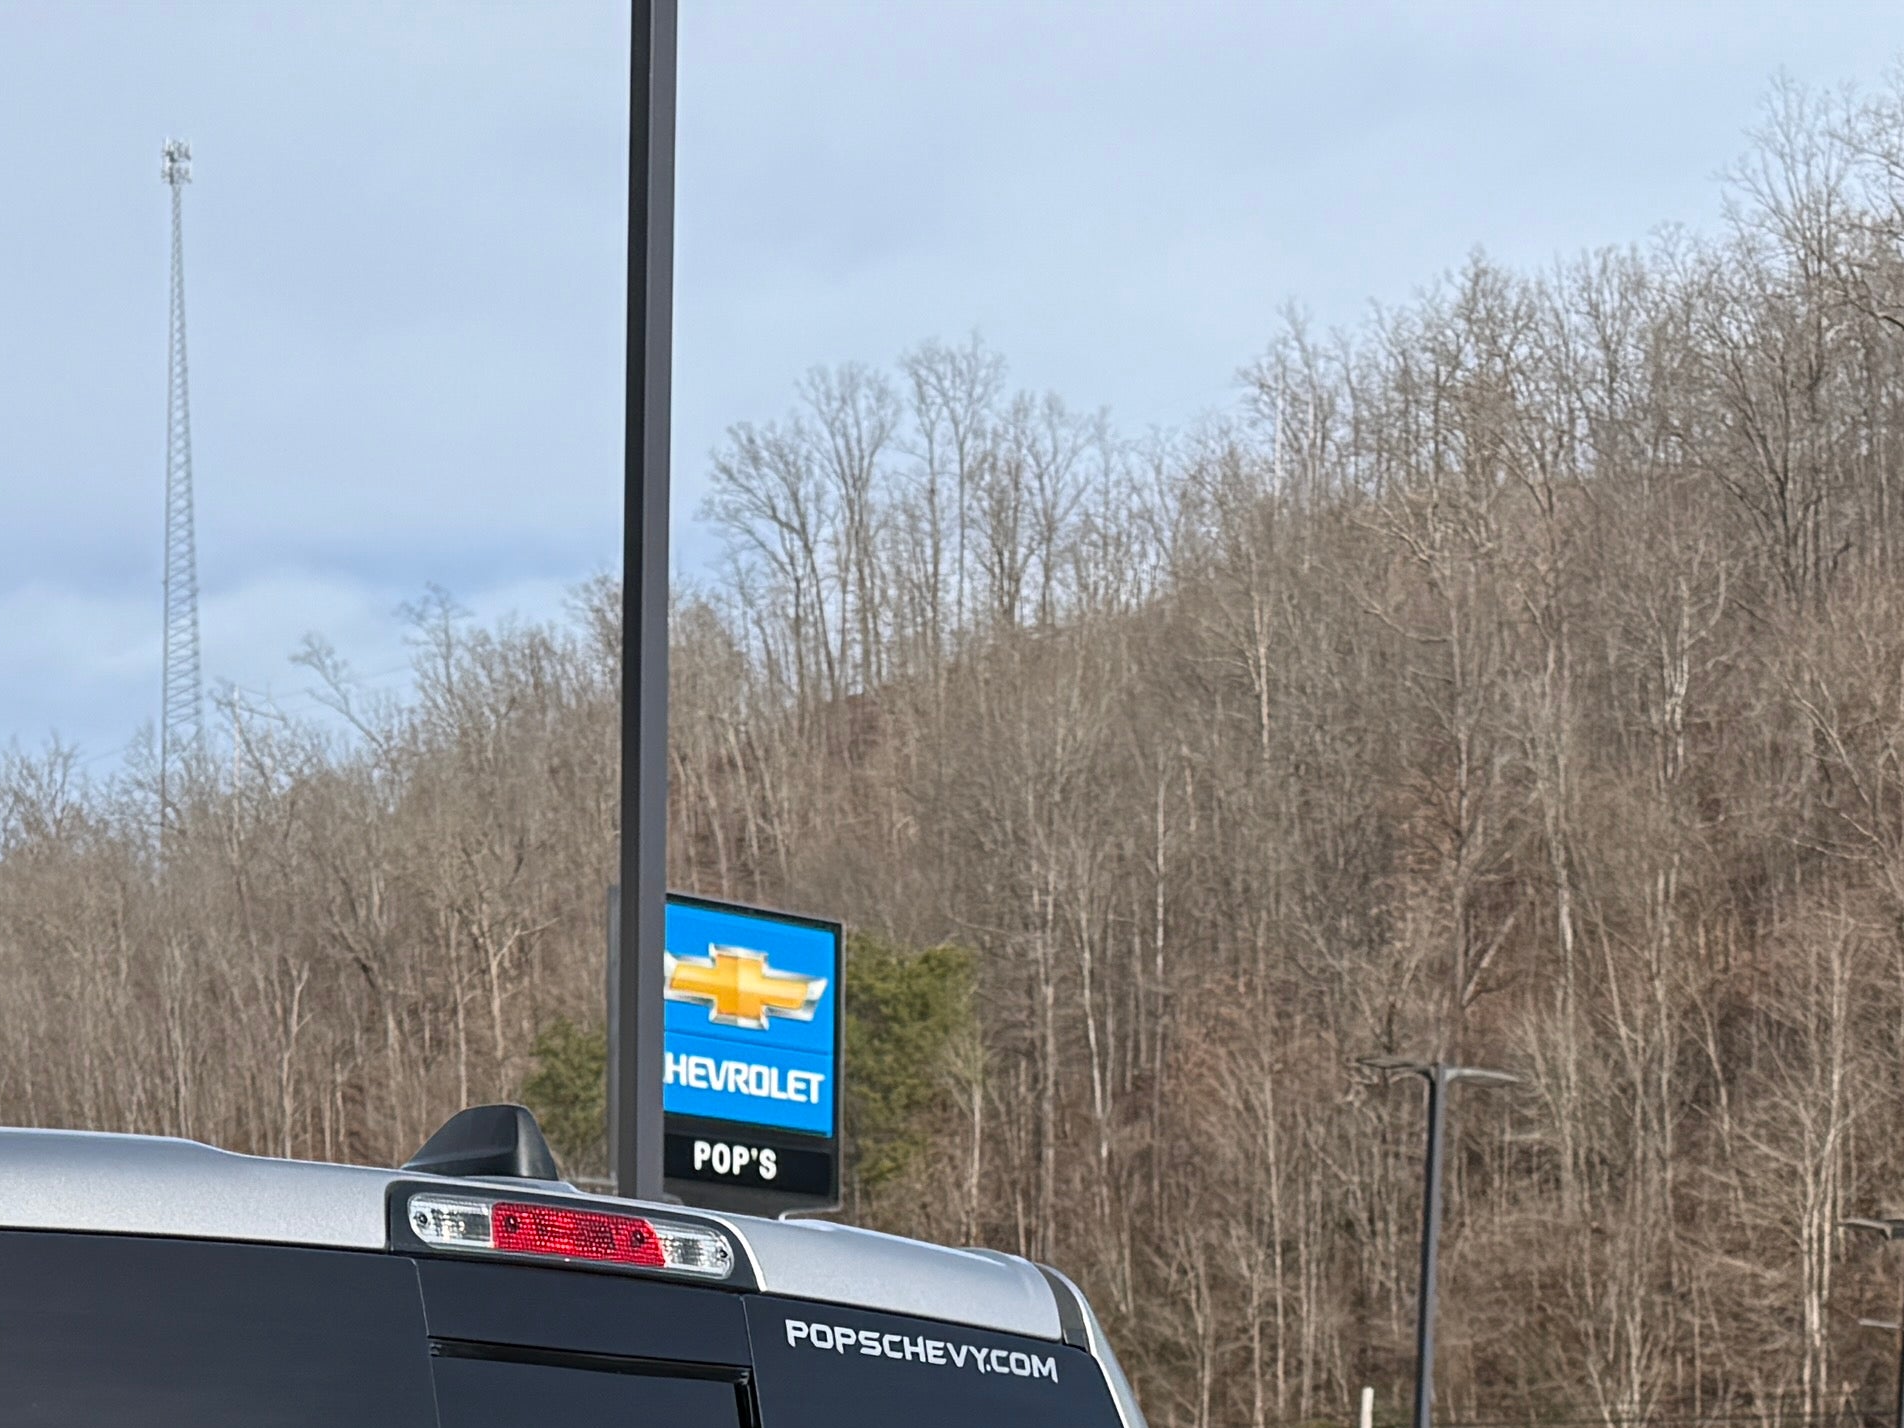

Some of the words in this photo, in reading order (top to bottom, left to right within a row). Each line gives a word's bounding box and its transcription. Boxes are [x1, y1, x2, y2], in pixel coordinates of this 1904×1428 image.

[663, 1051, 825, 1104] HEVROLET
[693, 1140, 777, 1180] POP'S
[785, 1319, 1059, 1384] POPSCHEVY.COM
